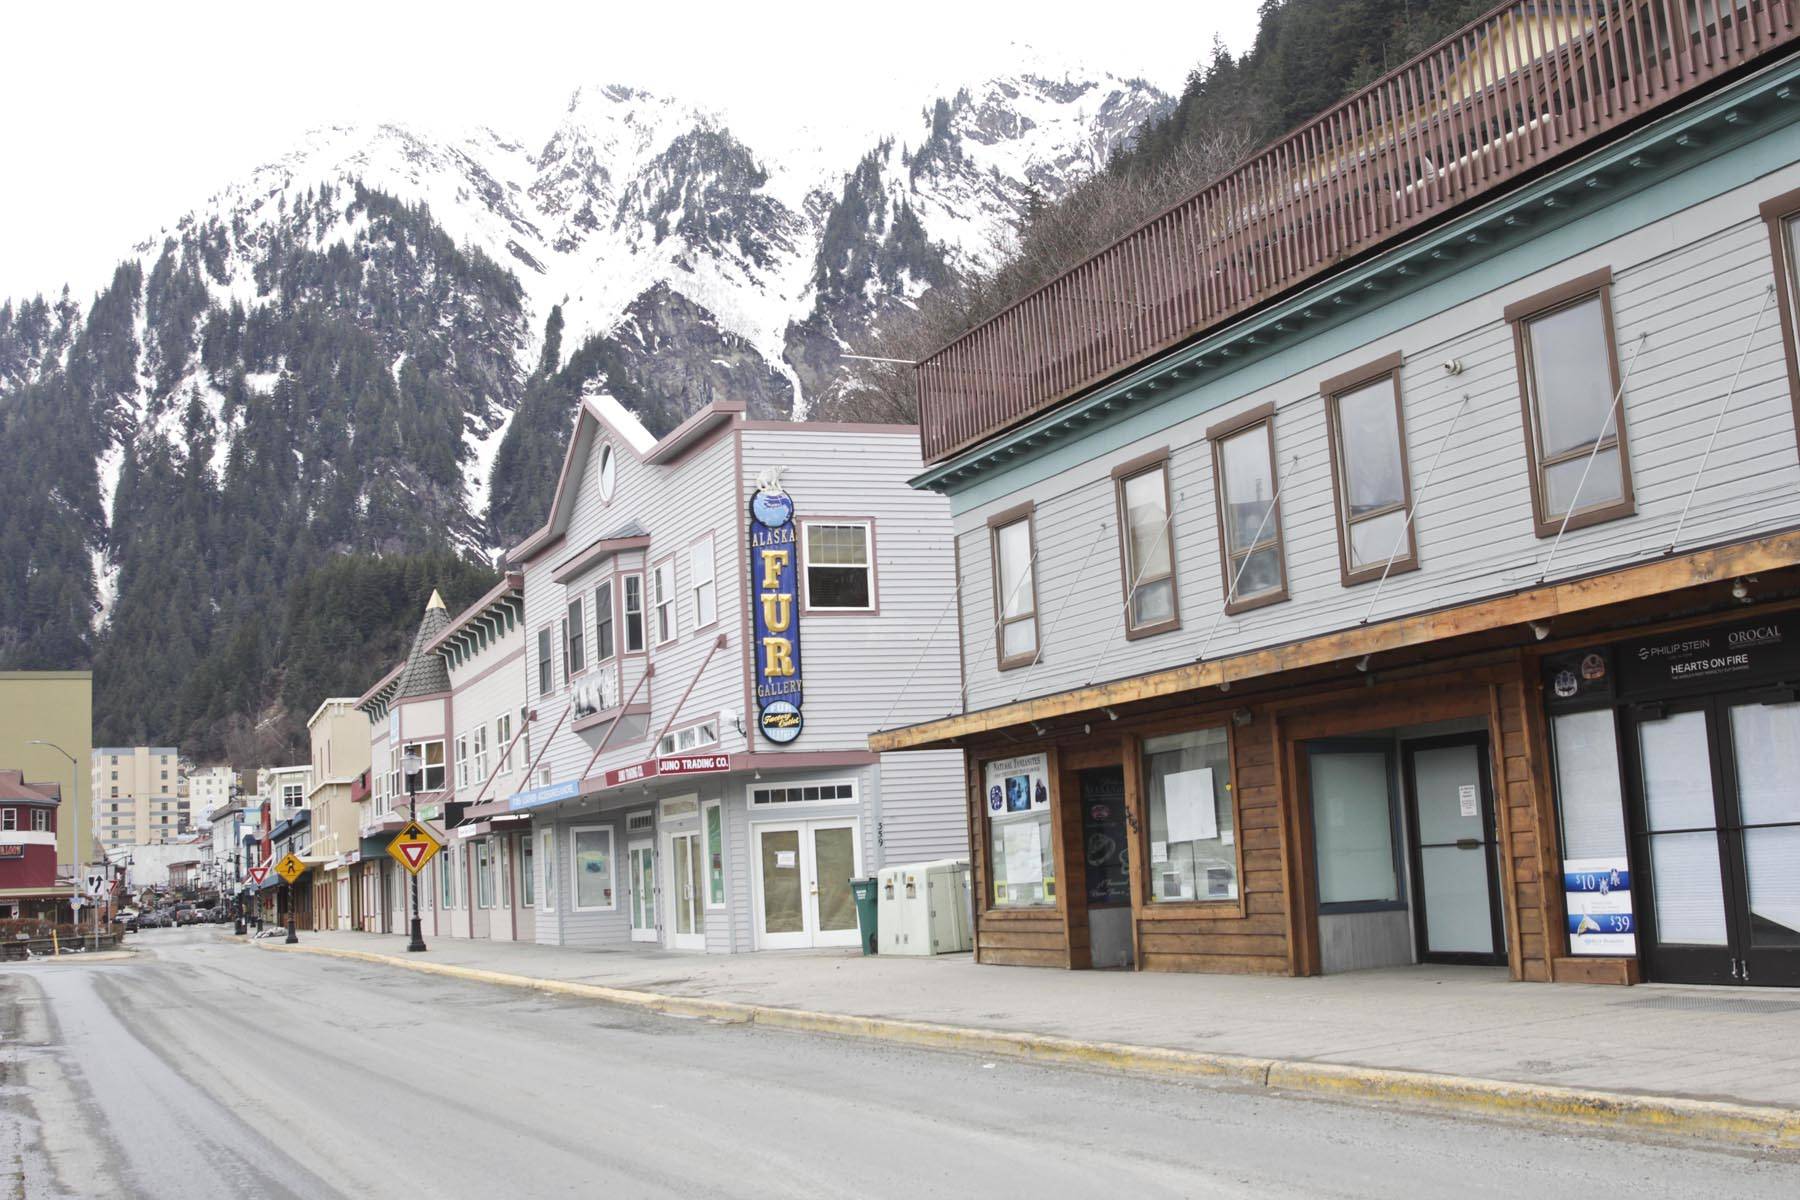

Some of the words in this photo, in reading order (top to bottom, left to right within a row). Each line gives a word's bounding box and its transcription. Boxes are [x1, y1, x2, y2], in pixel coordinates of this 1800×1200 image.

[752, 529, 796, 547] ALASKA
[761, 550, 795, 677] FUR
[1728, 625, 1782, 643] OROCAL
[1650, 643, 1681, 657] PHILIP
[1681, 639, 1711, 652] STEIN
[1671, 660, 1709, 674] HEARTS
[1710, 657, 1726, 668] ON
[1726, 654, 1749, 665] FIRE
[758, 680, 802, 697] GALLERY
[660, 760, 680, 771] JUNO
[682, 758, 714, 770] TRADING
[716, 757, 729, 768] CO.
[1576, 874, 1596, 890] $10
[1610, 915, 1631, 932] $39
